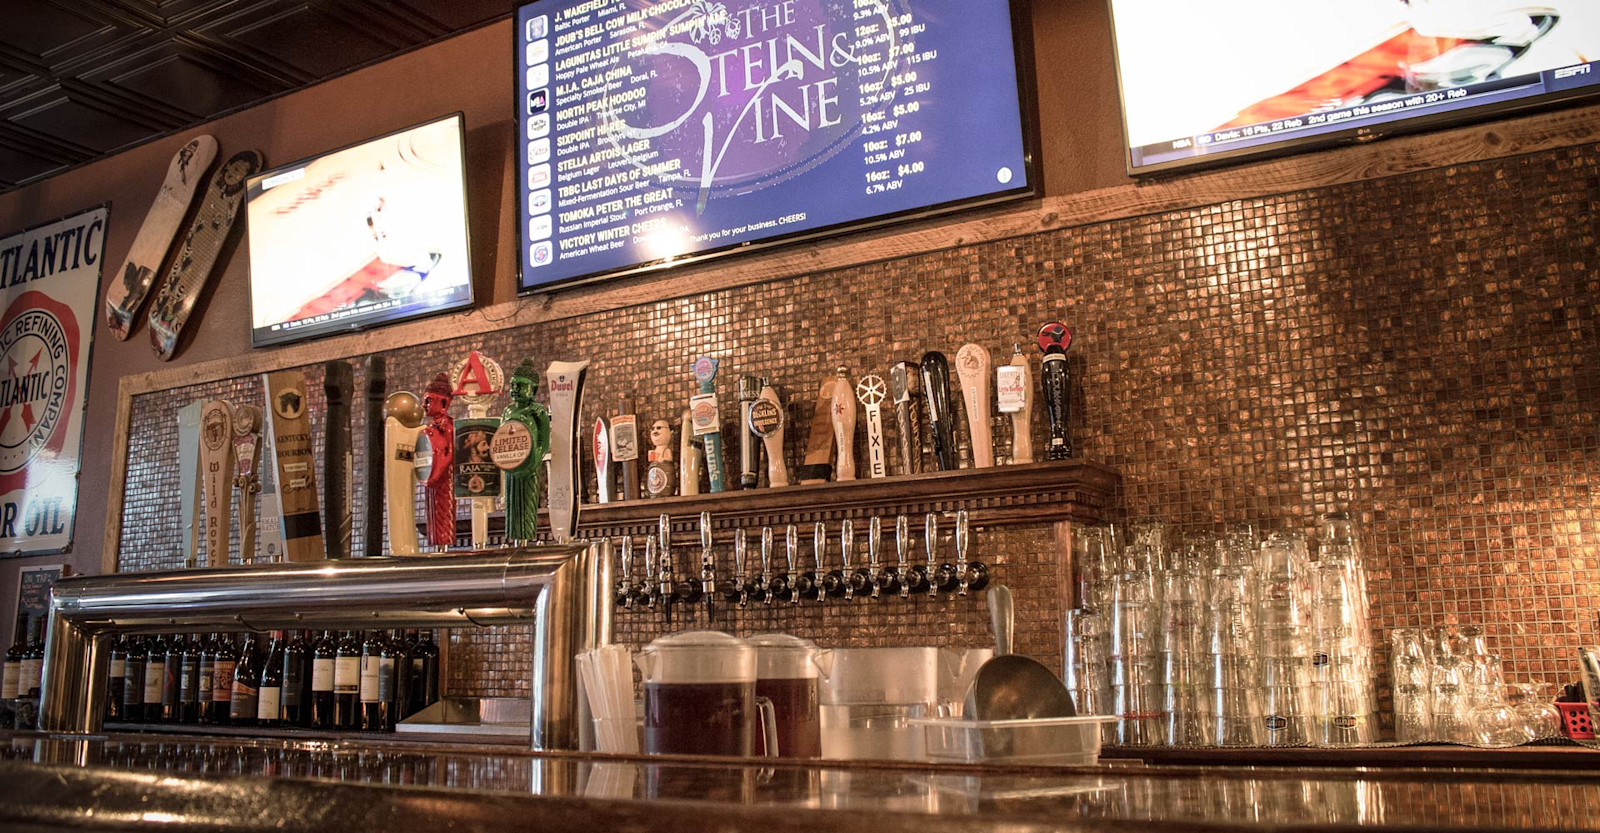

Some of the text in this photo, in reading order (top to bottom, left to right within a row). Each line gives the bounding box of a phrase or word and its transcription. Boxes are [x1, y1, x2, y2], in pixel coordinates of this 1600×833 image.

[554, 0, 608, 22] J. WAKEFIELD
[555, 22, 571, 32] Baltic
[572, 15, 590, 26] Porter
[597, 6, 618, 18] Miami,
[737, 1, 796, 39] THE
[853, 4, 889, 20] 9.3% ABV
[555, 9, 648, 47] JDUB'S BELL COW MILK
[555, 43, 583, 56] American
[584, 35, 602, 48] Porter
[638, 21, 646, 29] FL
[855, 13, 912, 37] 12oz: $5.00
[855, 23, 926, 49] 9.0% ABV 99 IBU
[555, 49, 601, 71] LAGUNITAS
[602, 38, 630, 57] LITTLE
[709, 10, 727, 25] ALE
[829, 32, 858, 67] &
[857, 42, 914, 65] 10oz: $7.00
[556, 56, 620, 81] Hoppy Pale Wheat Ale
[858, 50, 937, 77] 10.5% ABV 115 IBU
[1554, 63, 1591, 79] ESPN
[556, 65, 633, 97] M.I.A. CAJA CHINA
[556, 70, 658, 106] Specialty Smoked Beer Doral, FL
[859, 71, 917, 94] 16oz: $5.00
[860, 82, 930, 107] 5.2% ABV 25 IBU
[556, 87, 646, 121] NORTH PEAK HOODOO
[557, 99, 646, 131] Double IPA Traverse City, MI
[861, 101, 919, 124] 16oz: $5.00
[861, 119, 898, 135] 4.2% ABV
[1172, 138, 1192, 149] NBA
[1214, 131, 1240, 141] Davis:
[1253, 124, 1271, 134] Pts,
[1271, 122, 1283, 130] 22
[1284, 118, 1302, 130] Reb
[1308, 114, 1326, 125] 2nd
[1327, 110, 1351, 123] game
[1353, 105, 1370, 116] this
[1371, 99, 1404, 113] season
[1405, 94, 1425, 106] with
[1426, 92, 1445, 103] 20+
[1447, 88, 1467, 99] Reb
[557, 119, 626, 146] SIXPOINT HI-RES
[863, 130, 922, 153] 10oz: $7.00
[557, 142, 590, 156] Double IPA
[558, 138, 650, 172] STELLA ARTOIS LAGER
[864, 148, 905, 165] 10.5% ABV
[558, 170, 583, 182] Belgium
[583, 165, 600, 176] Lager
[632, 150, 659, 163] Belgium
[558, 158, 681, 199] TBBC LAST DAYS OF SUMMER
[865, 160, 924, 183] 16oz: $4.00
[558, 187, 618, 208] Mixed-Fermentation
[618, 183, 634, 193] Sour
[635, 179, 650, 190] Beer
[658, 172, 683, 184] Tampa,
[866, 179, 903, 194] 6.7% ABV
[558, 187, 673, 224] TOMOKA PETER THE GREAT
[558, 199, 683, 234] Russian Imperial Stout Port Orange, FL
[559, 233, 598, 250] VICTORY
[597, 225, 631, 242] WINTER
[632, 217, 667, 234] CHEERS
[690, 232, 708, 243] Thank
[708, 230, 721, 241] you
[721, 228, 731, 236] for
[731, 225, 747, 237] your
[747, 218, 778, 231] business.
[778, 212, 806, 225] CHEERS!
[0, 219, 102, 290] TLANTIC
[560, 240, 625, 260] American Wheat Beer
[15, 315, 64, 360] REFINING
[0, 371, 50, 407] TLANTIC
[551, 380, 573, 391] Duvel
[28, 365, 65, 456] COMPANY
[277, 433, 311, 443] KENTUCKY
[492, 442, 530, 454] RELEASE
[494, 436, 528, 447] LIMITED
[868, 409, 882, 475] FIXIE
[278, 447, 312, 457] BOURBON
[459, 464, 481, 474] RAJA
[209, 462, 219, 509] Wild
[25, 497, 64, 536] OIL
